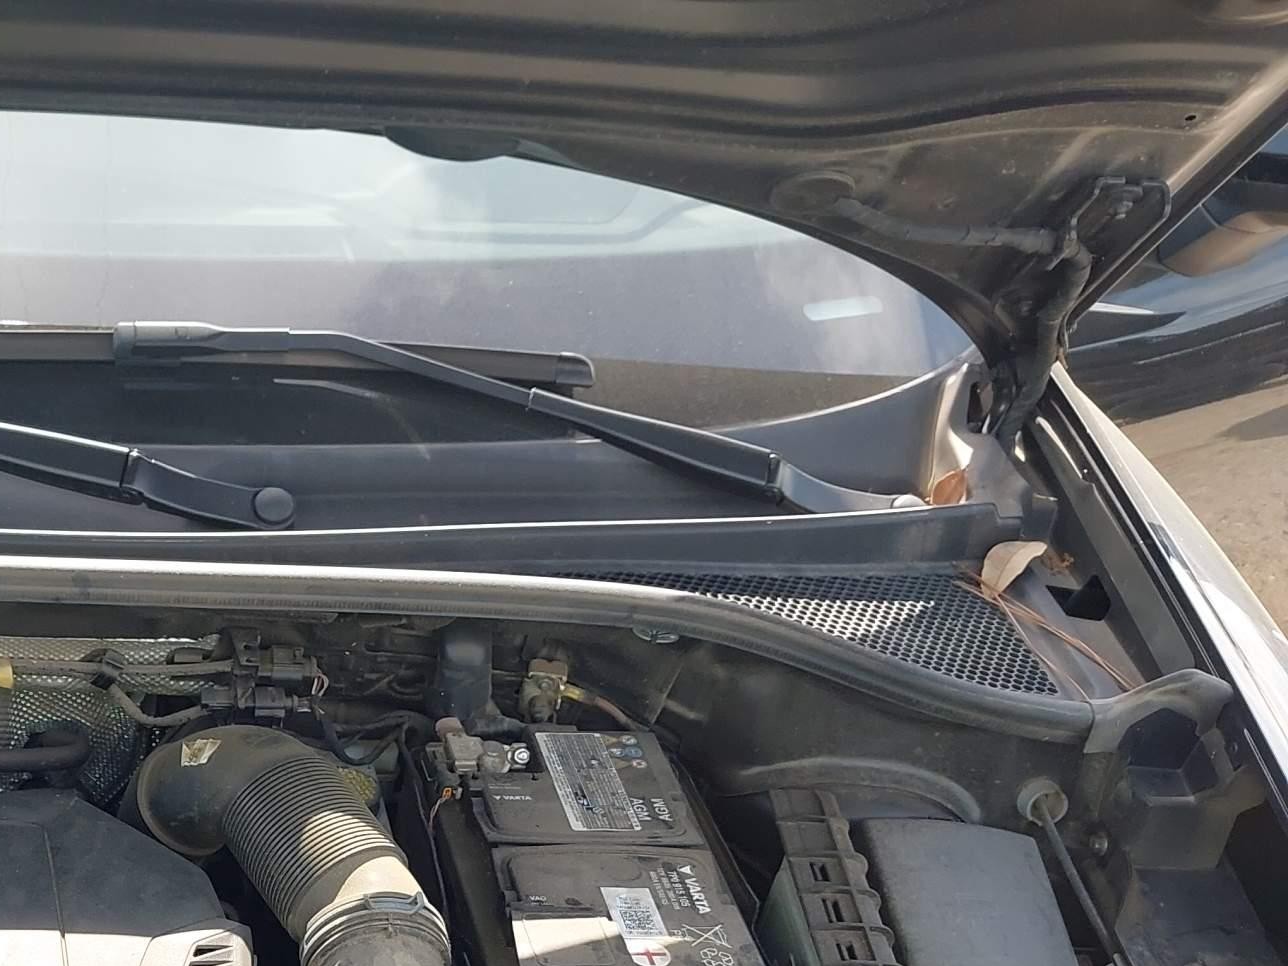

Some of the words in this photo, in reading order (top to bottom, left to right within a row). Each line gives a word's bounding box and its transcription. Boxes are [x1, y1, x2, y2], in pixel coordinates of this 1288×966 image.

[630, 797, 652, 821] AGM
[650, 798, 673, 822] AGM
[685, 877, 711, 914] VARTA
